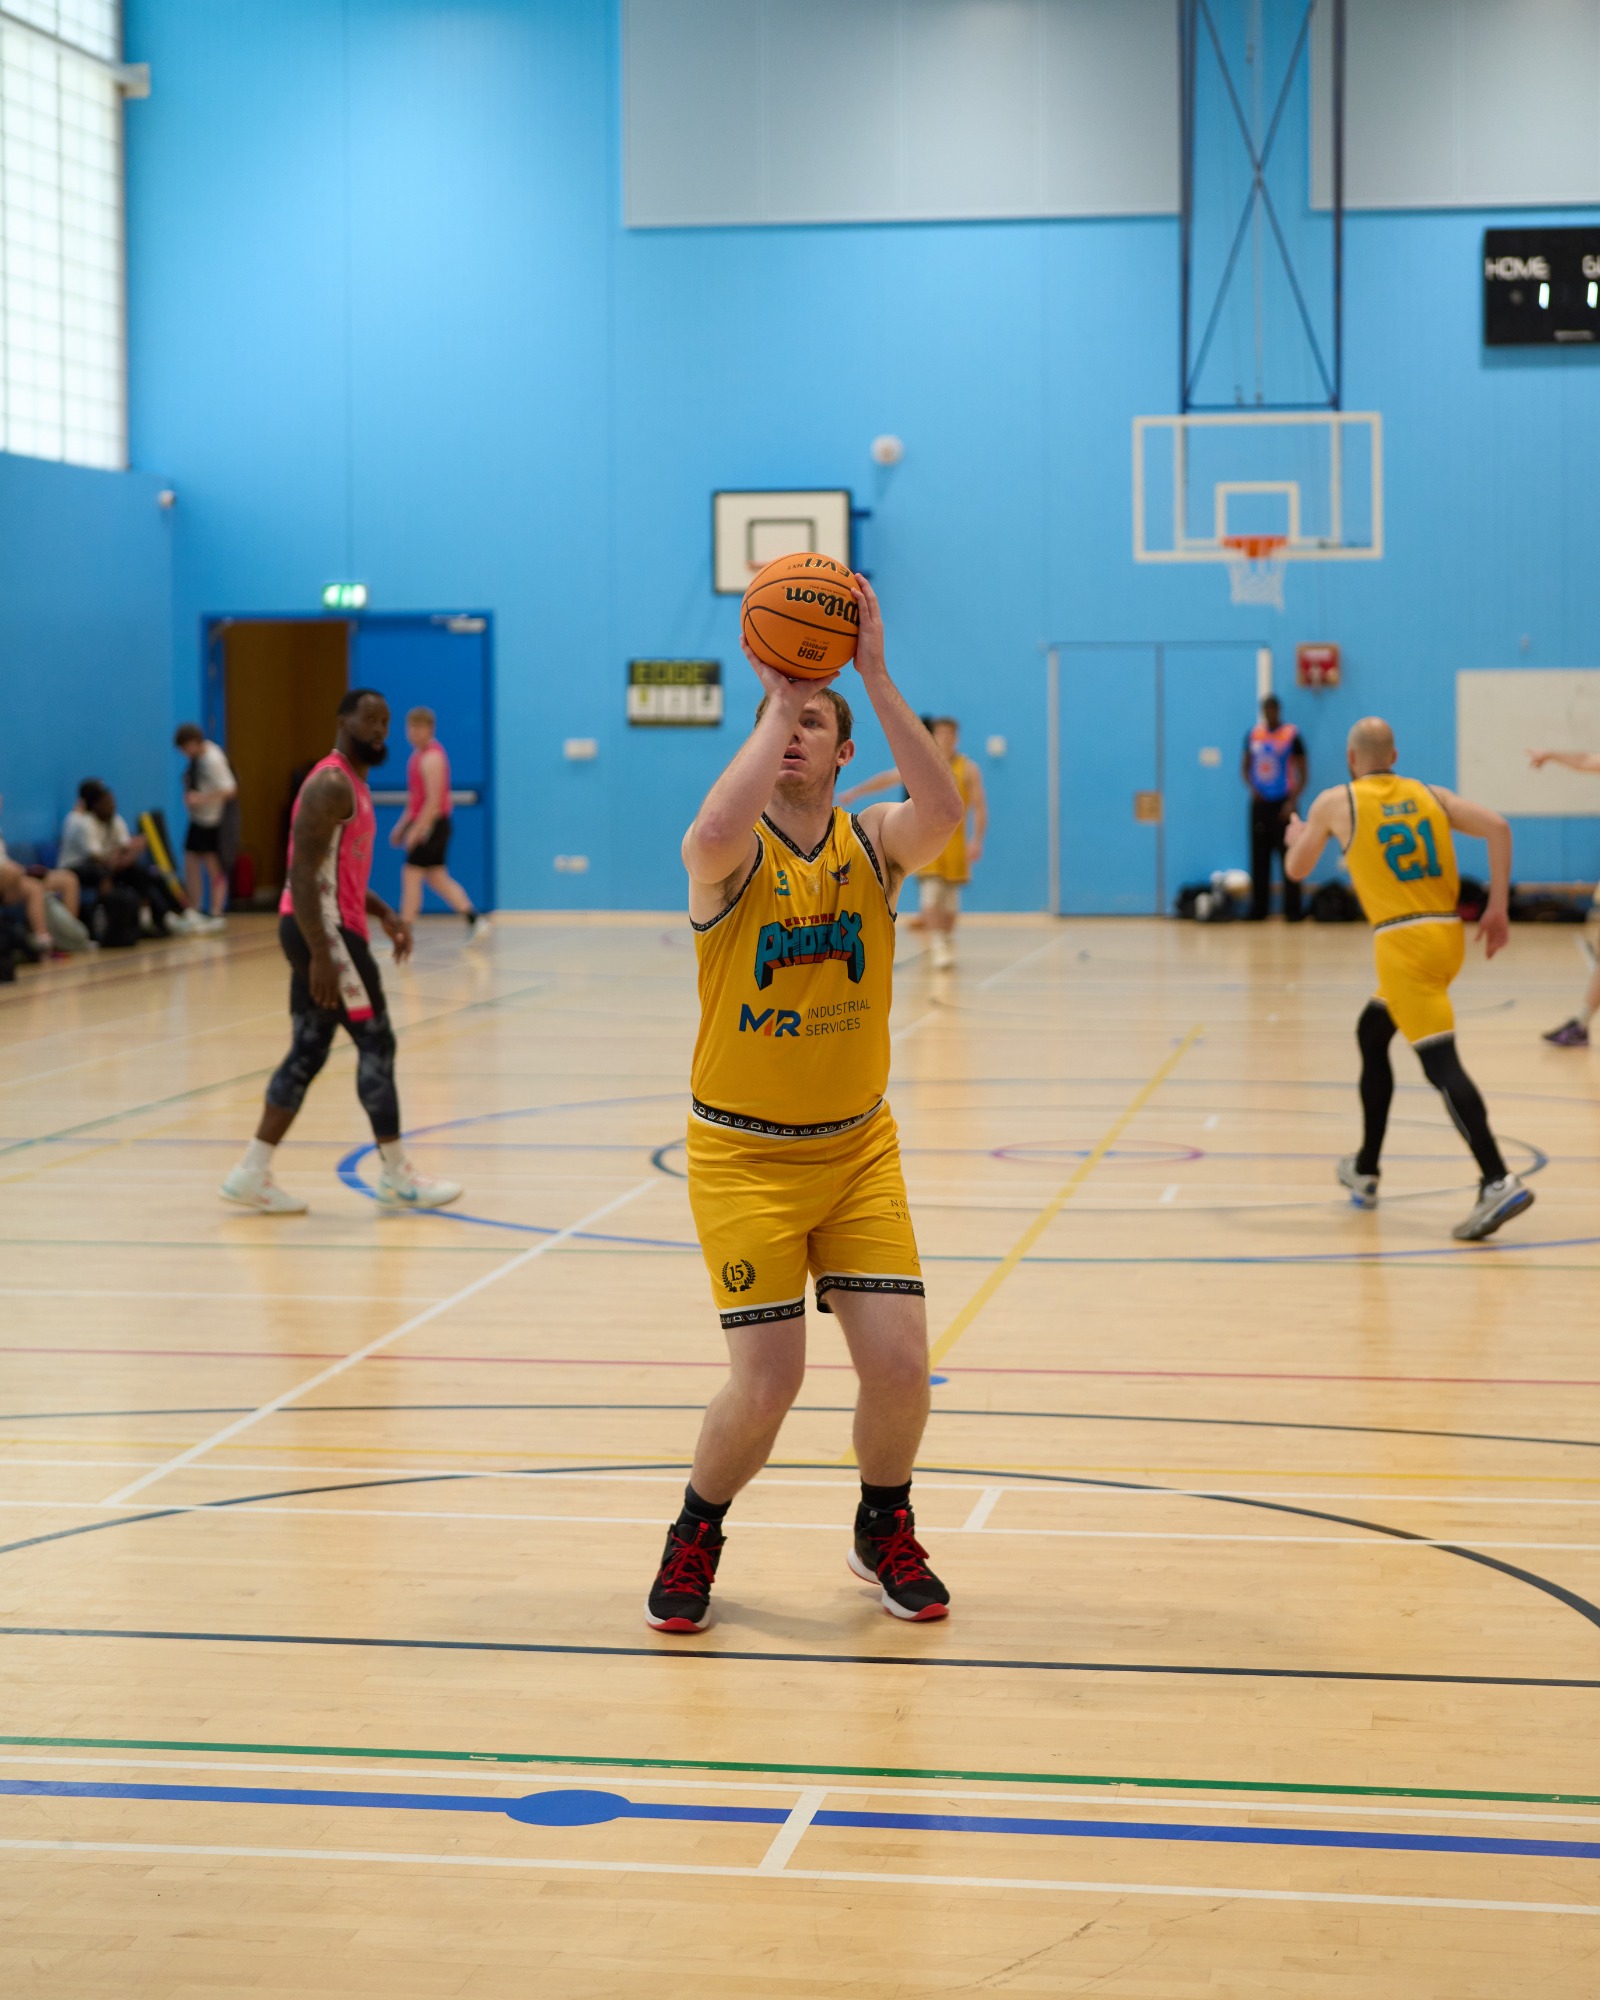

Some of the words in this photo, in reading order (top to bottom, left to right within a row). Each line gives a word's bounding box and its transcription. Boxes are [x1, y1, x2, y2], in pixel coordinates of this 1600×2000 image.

[1485, 255, 1551, 281] HOME
[805, 558, 850, 578] EVO
[785, 586, 859, 628] Wilson
[797, 645, 826, 662] FIBA
[1377, 818, 1442, 881] 21
[739, 1003, 802, 1037] MR
[807, 998, 871, 1020] INDUSTRIAL
[805, 1018, 861, 1037] SERVICES
[890, 1199, 908, 1209] NO
[729, 1264, 744, 1281] 15
